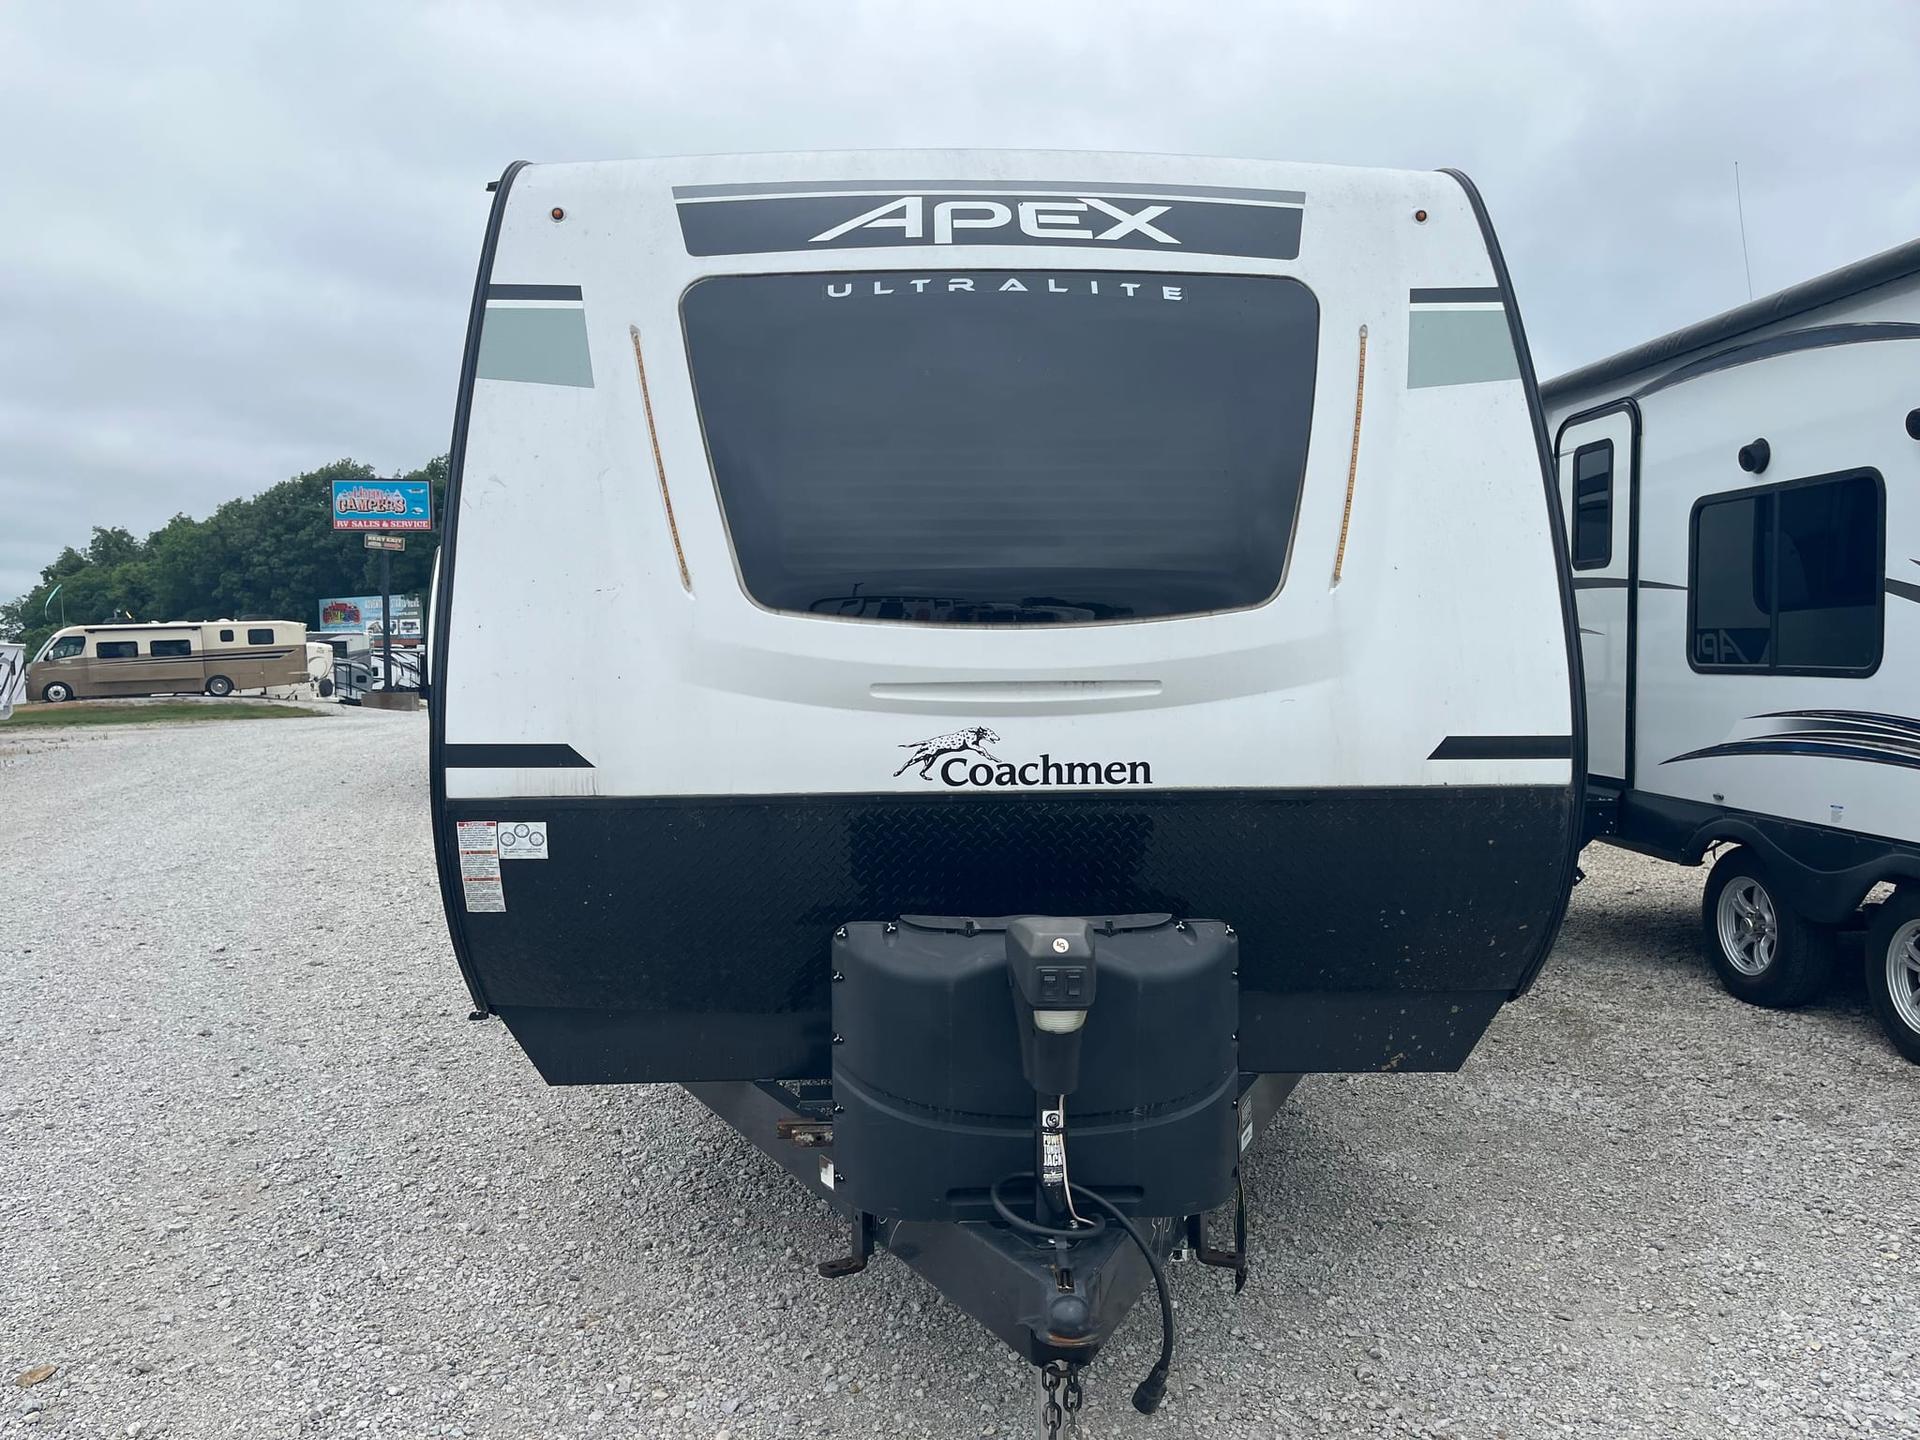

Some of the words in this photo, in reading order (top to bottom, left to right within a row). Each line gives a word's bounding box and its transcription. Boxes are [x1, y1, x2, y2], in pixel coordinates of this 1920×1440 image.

[808, 196, 1182, 244] APEX
[827, 277, 1183, 301] ULTRALITE
[336, 498, 406, 513] CAMPERS
[337, 520, 349, 528] RV
[352, 520, 380, 528] SALES
[382, 520, 389, 528] &
[391, 520, 428, 528] SERVICE
[940, 754, 1153, 787] Coachmen
[1043, 1154, 1063, 1167] JACK
